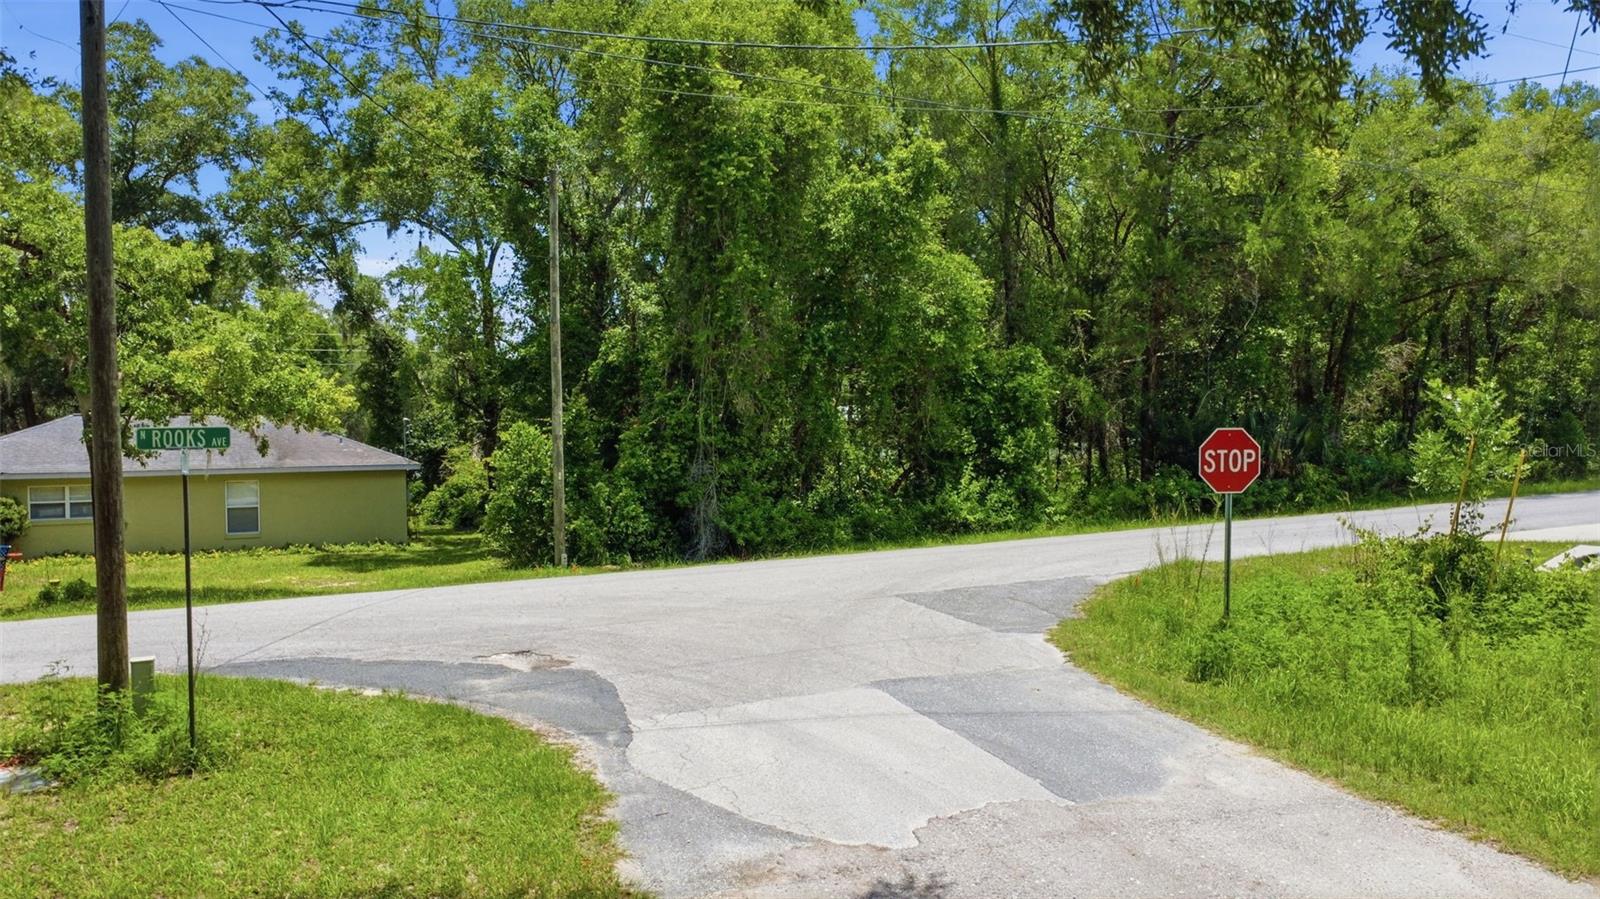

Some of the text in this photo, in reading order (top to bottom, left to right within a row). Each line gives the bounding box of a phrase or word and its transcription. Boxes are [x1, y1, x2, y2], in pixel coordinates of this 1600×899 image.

[140, 430, 226, 448] N ROOKS AVE
[1204, 449, 1256, 472] STOP
